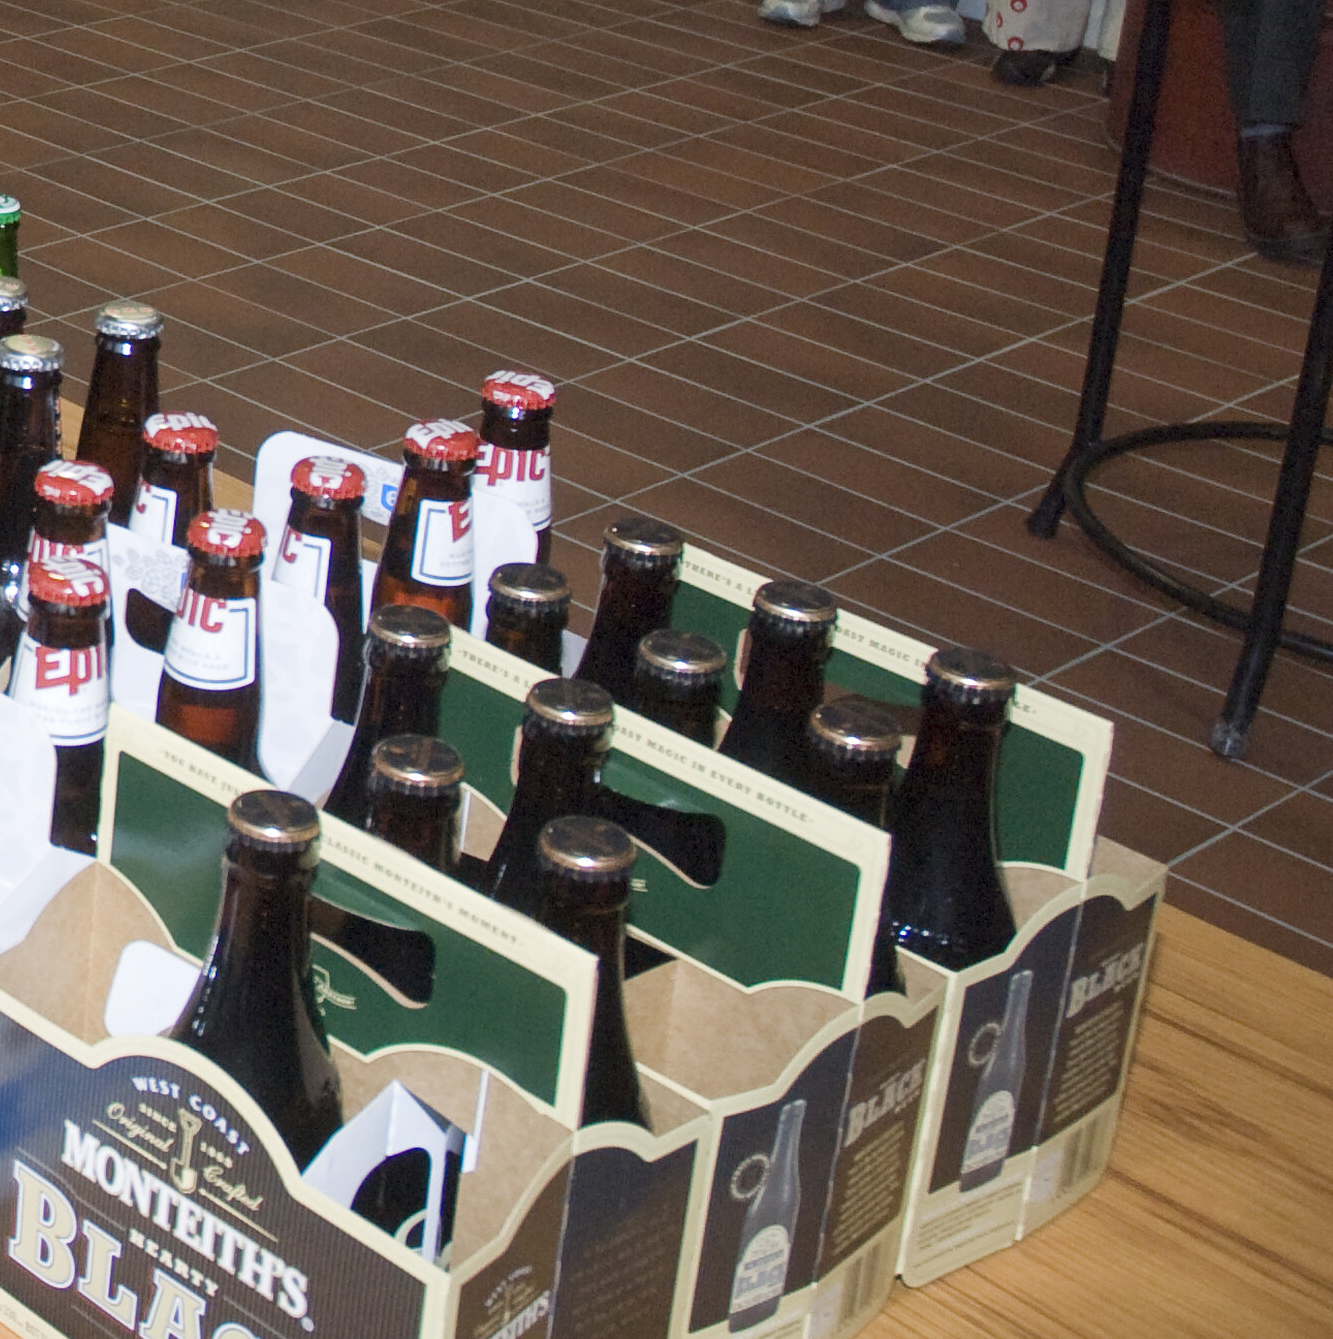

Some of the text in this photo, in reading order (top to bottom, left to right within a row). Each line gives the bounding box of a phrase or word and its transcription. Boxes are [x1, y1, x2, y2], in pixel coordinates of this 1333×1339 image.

[646, 740, 688, 766] MAGIC
[691, 759, 707, 774] IN
[709, 768, 754, 796] EVERY
[755, 790, 809, 824] BOTTLE
[106, 1102, 175, 1153] Original
[131, 1076, 251, 1156] WEST COAST
[202, 1165, 264, 1212] Crafted
[128, 1228, 219, 1297] HEARTY
